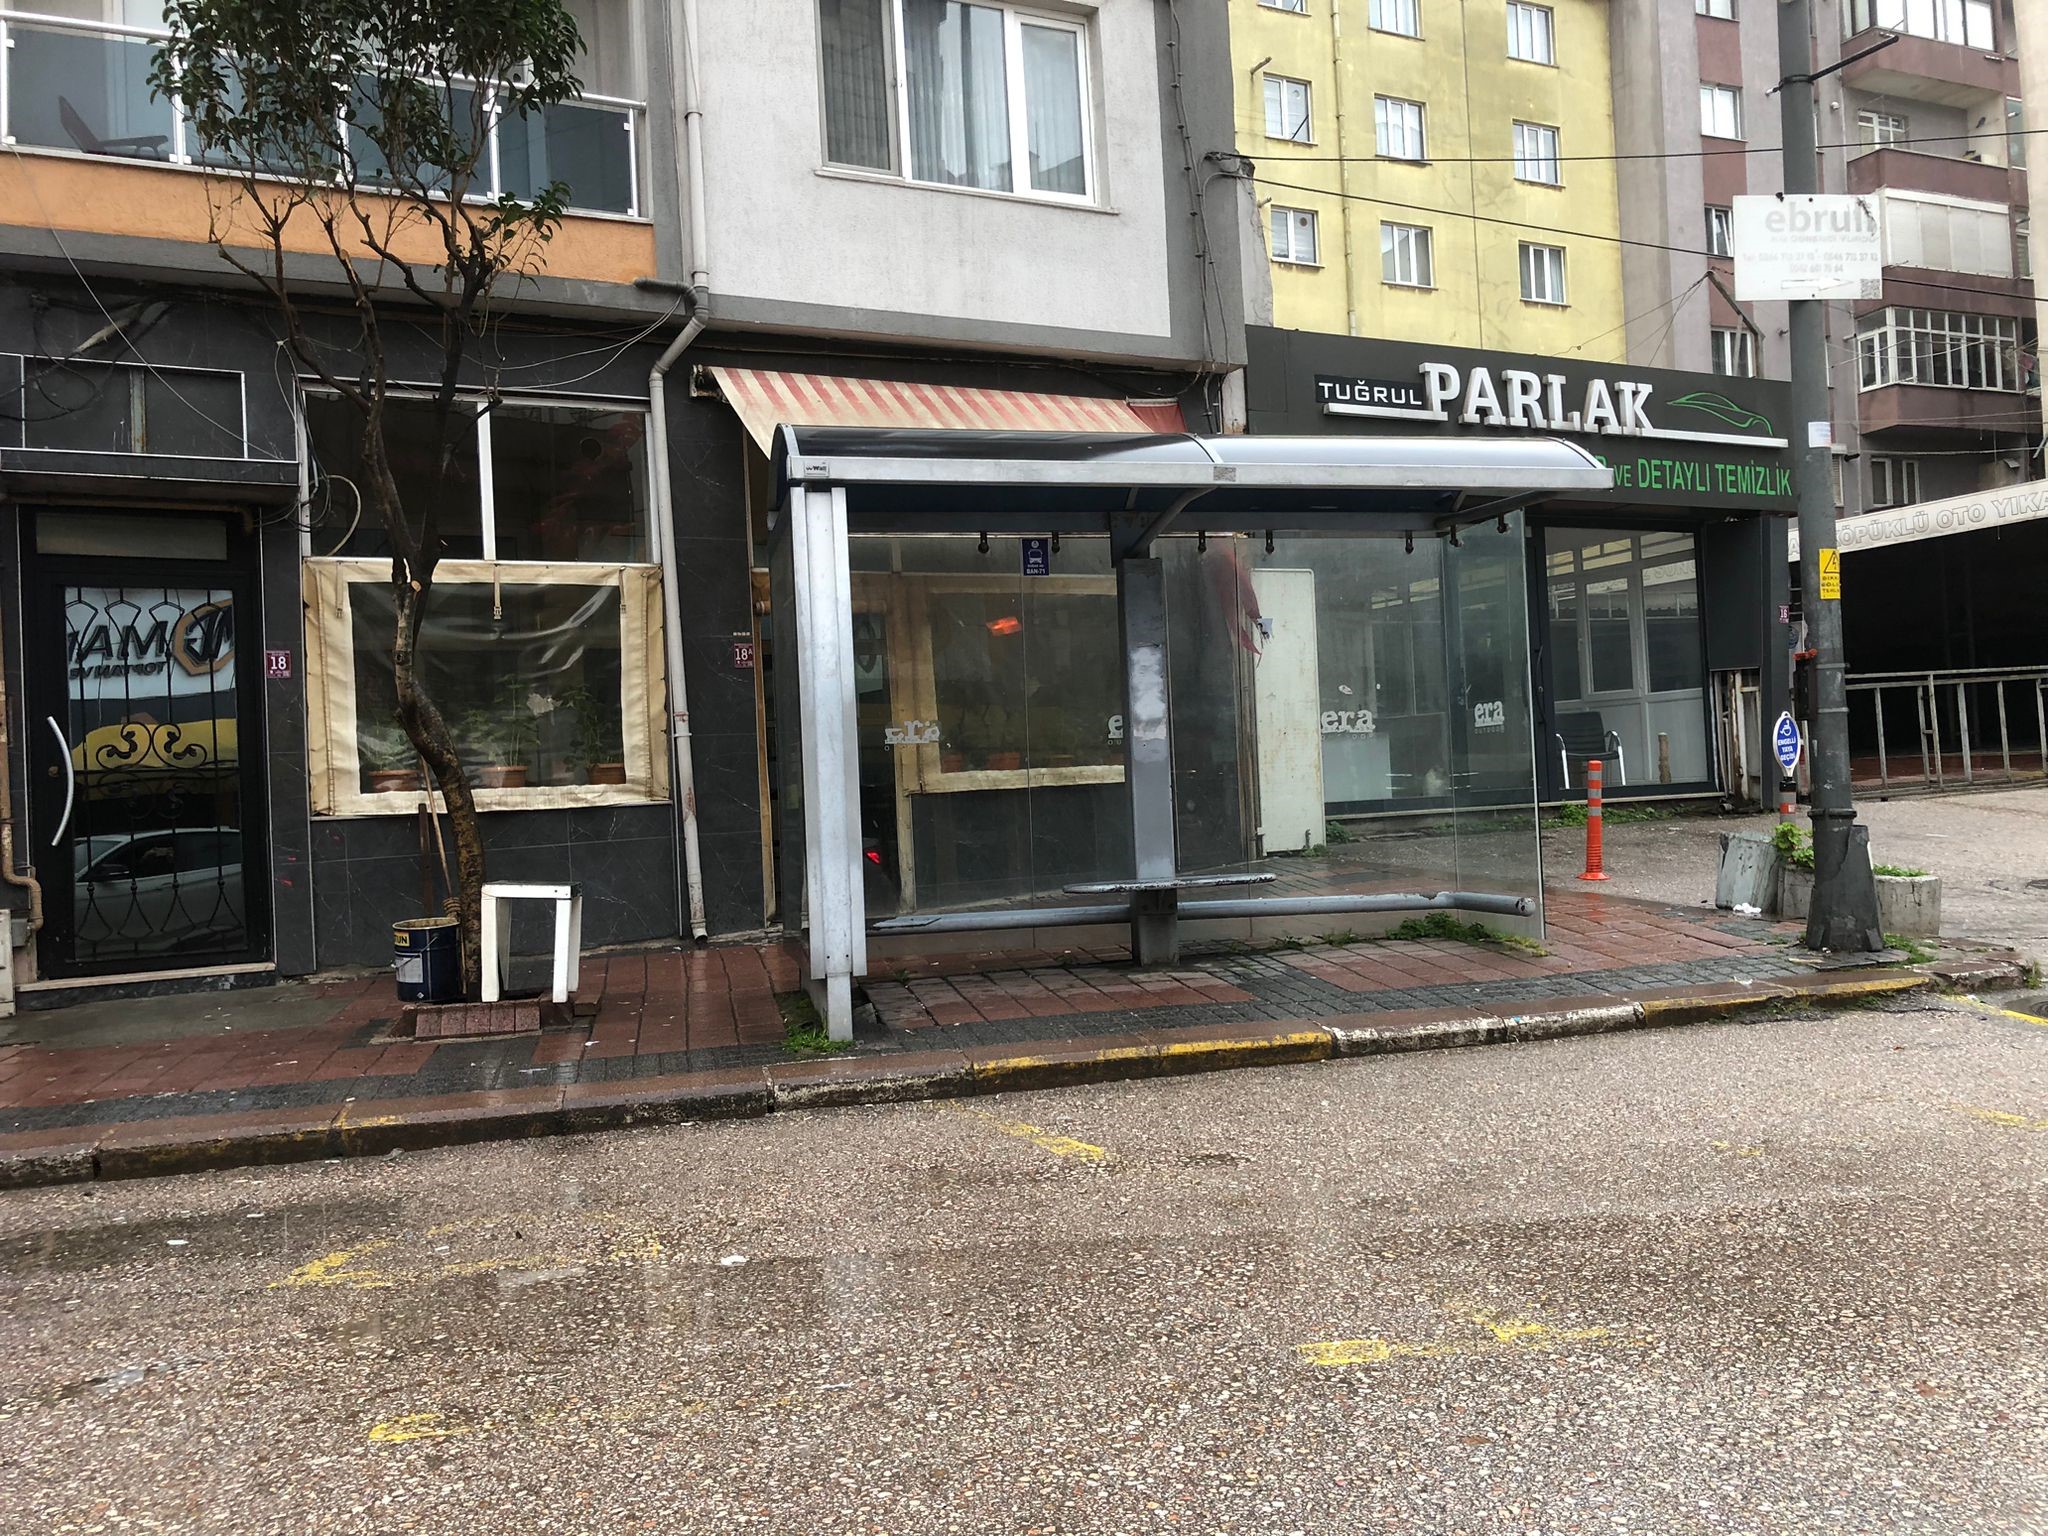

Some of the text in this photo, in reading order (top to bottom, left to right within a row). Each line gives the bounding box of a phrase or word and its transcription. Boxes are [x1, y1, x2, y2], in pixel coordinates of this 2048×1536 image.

[1318, 380, 1422, 406] TUĞRUL
[1418, 362, 1655, 437] PARLAK
[1637, 458, 1711, 492] DETAYLI
[1714, 459, 1793, 497] TEMİZLİK
[1936, 503, 1986, 529] OTO
[270, 656, 287, 670] 18
[1321, 709, 1375, 734] era
[1474, 700, 1505, 728] era
